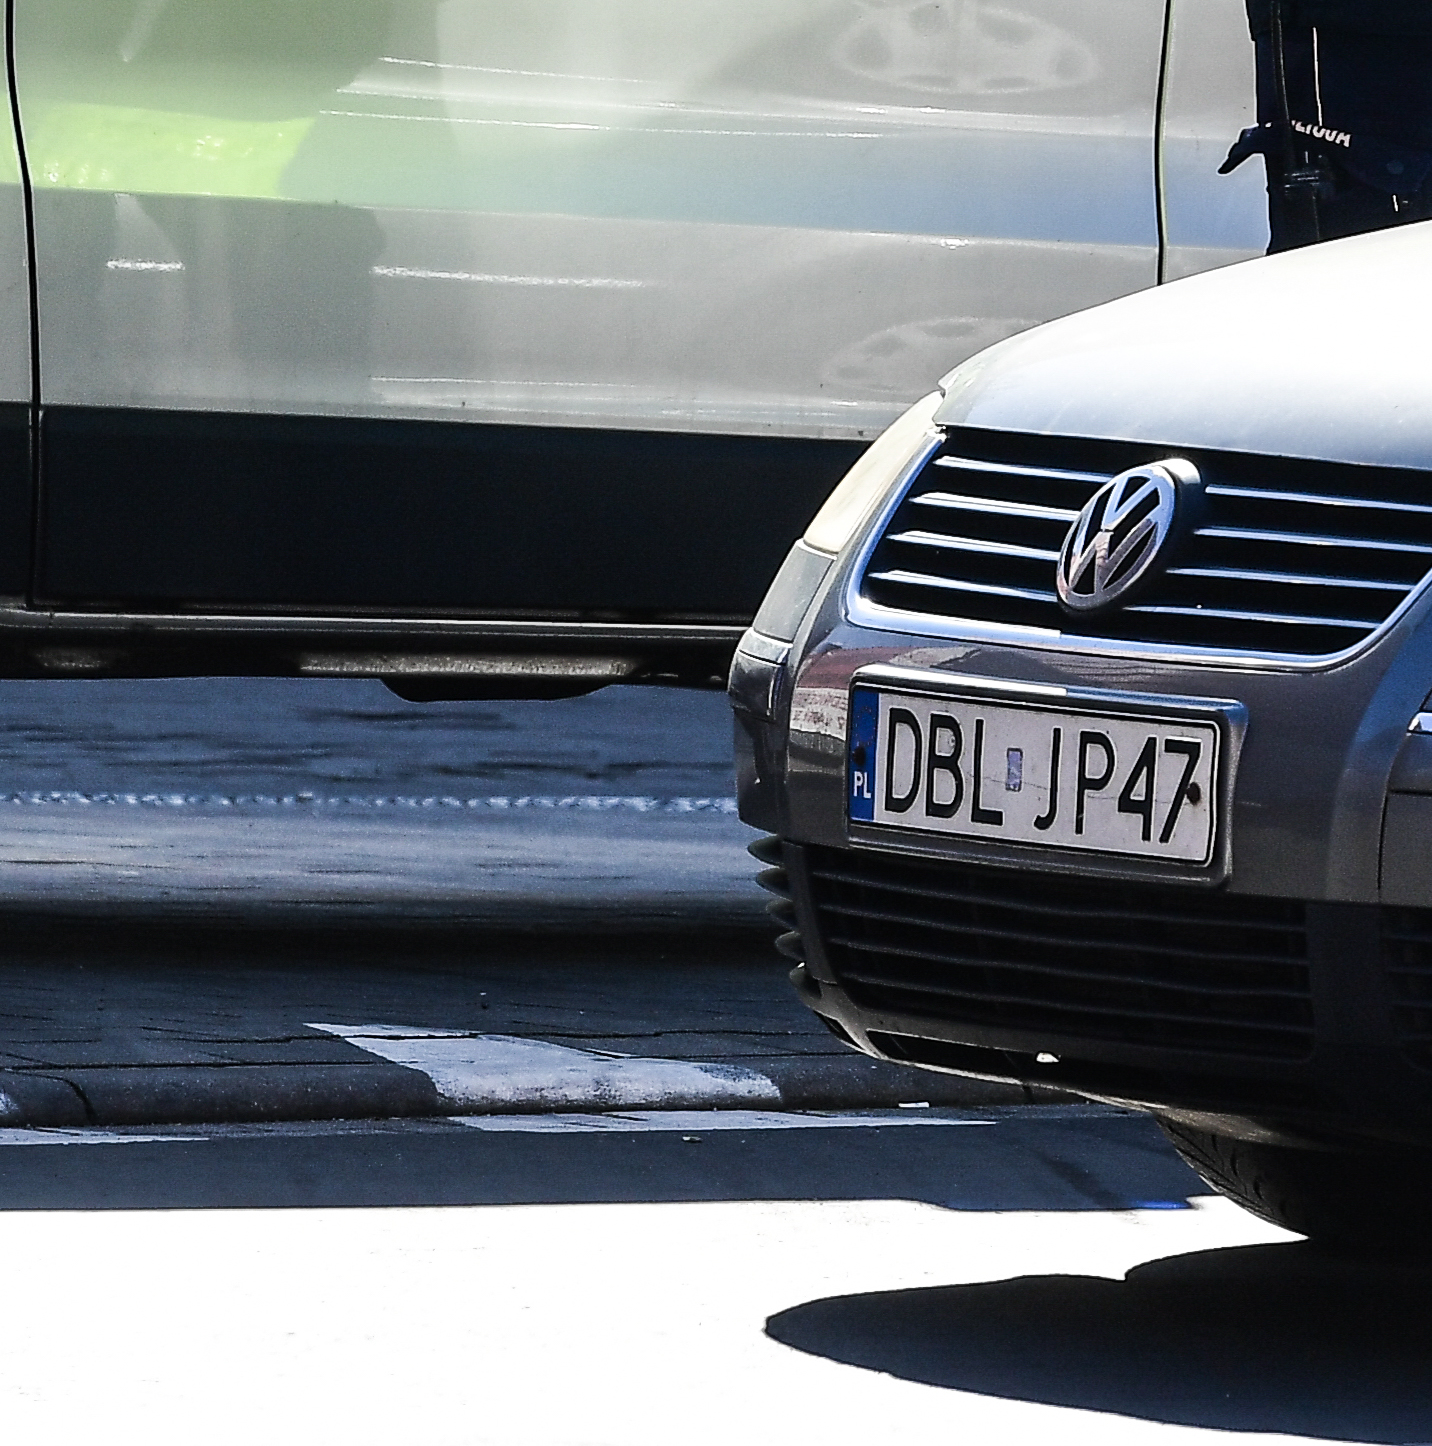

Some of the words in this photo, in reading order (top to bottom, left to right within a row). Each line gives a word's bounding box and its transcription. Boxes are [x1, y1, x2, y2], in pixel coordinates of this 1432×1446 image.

[853, 770, 872, 799] PL
[884, 706, 1003, 826] DBL
[1033, 726, 1201, 844] JP47
